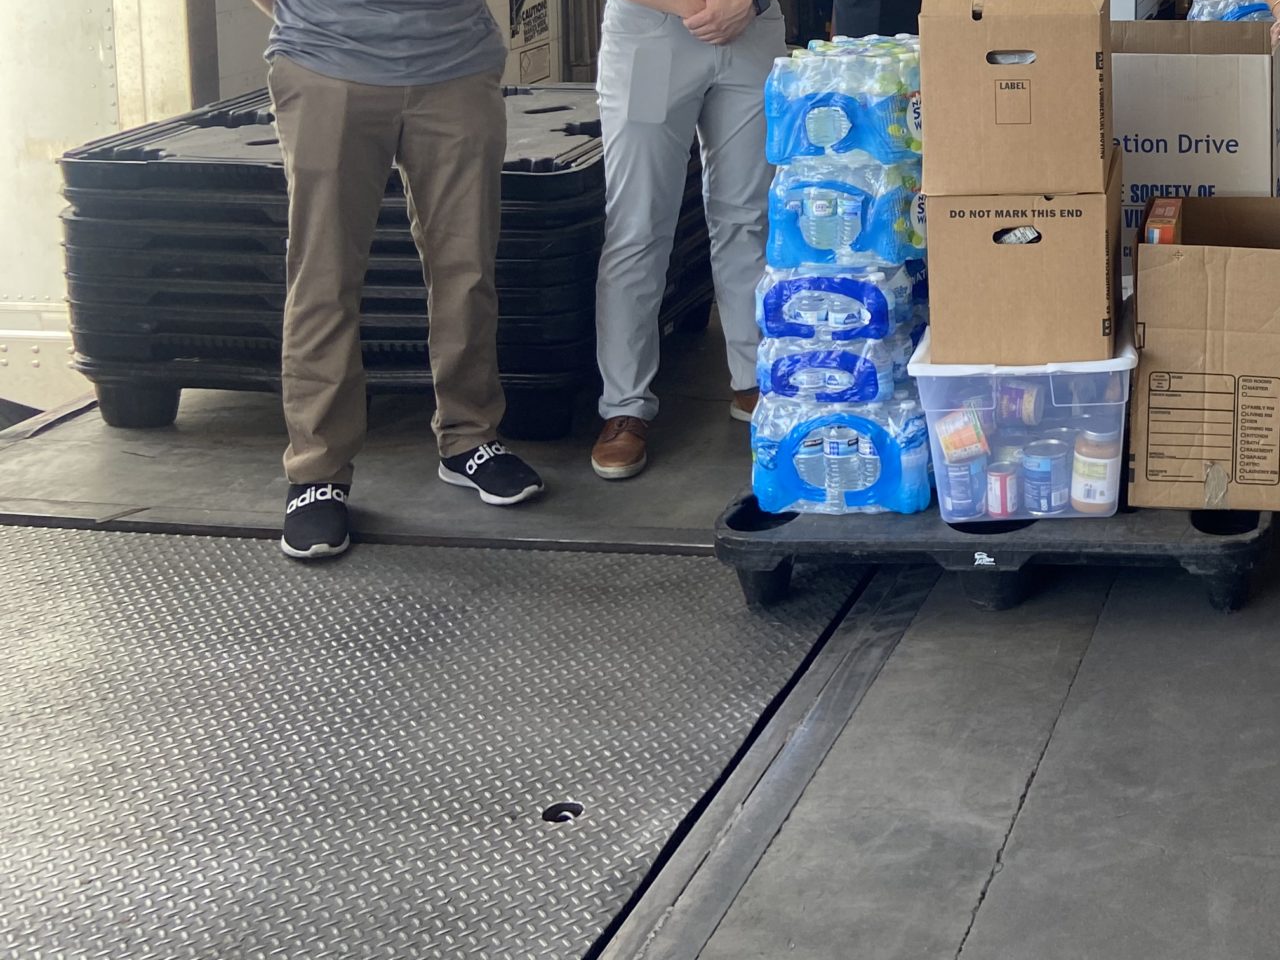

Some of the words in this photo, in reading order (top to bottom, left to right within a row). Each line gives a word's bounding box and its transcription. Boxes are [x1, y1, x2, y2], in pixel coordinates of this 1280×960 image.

[1000, 82, 1026, 90] LABEL
[1178, 134, 1239, 154] Drive
[1130, 184, 1192, 203] SOCIETY
[1198, 185, 1216, 197] OF
[950, 210, 966, 219] DO
[969, 209, 992, 218] NOT
[995, 209, 1028, 218] MARK
[1031, 209, 1057, 218] THIS
[1060, 209, 1083, 218] END
[465, 441, 512, 475] adid
[286, 483, 348, 514] adida
